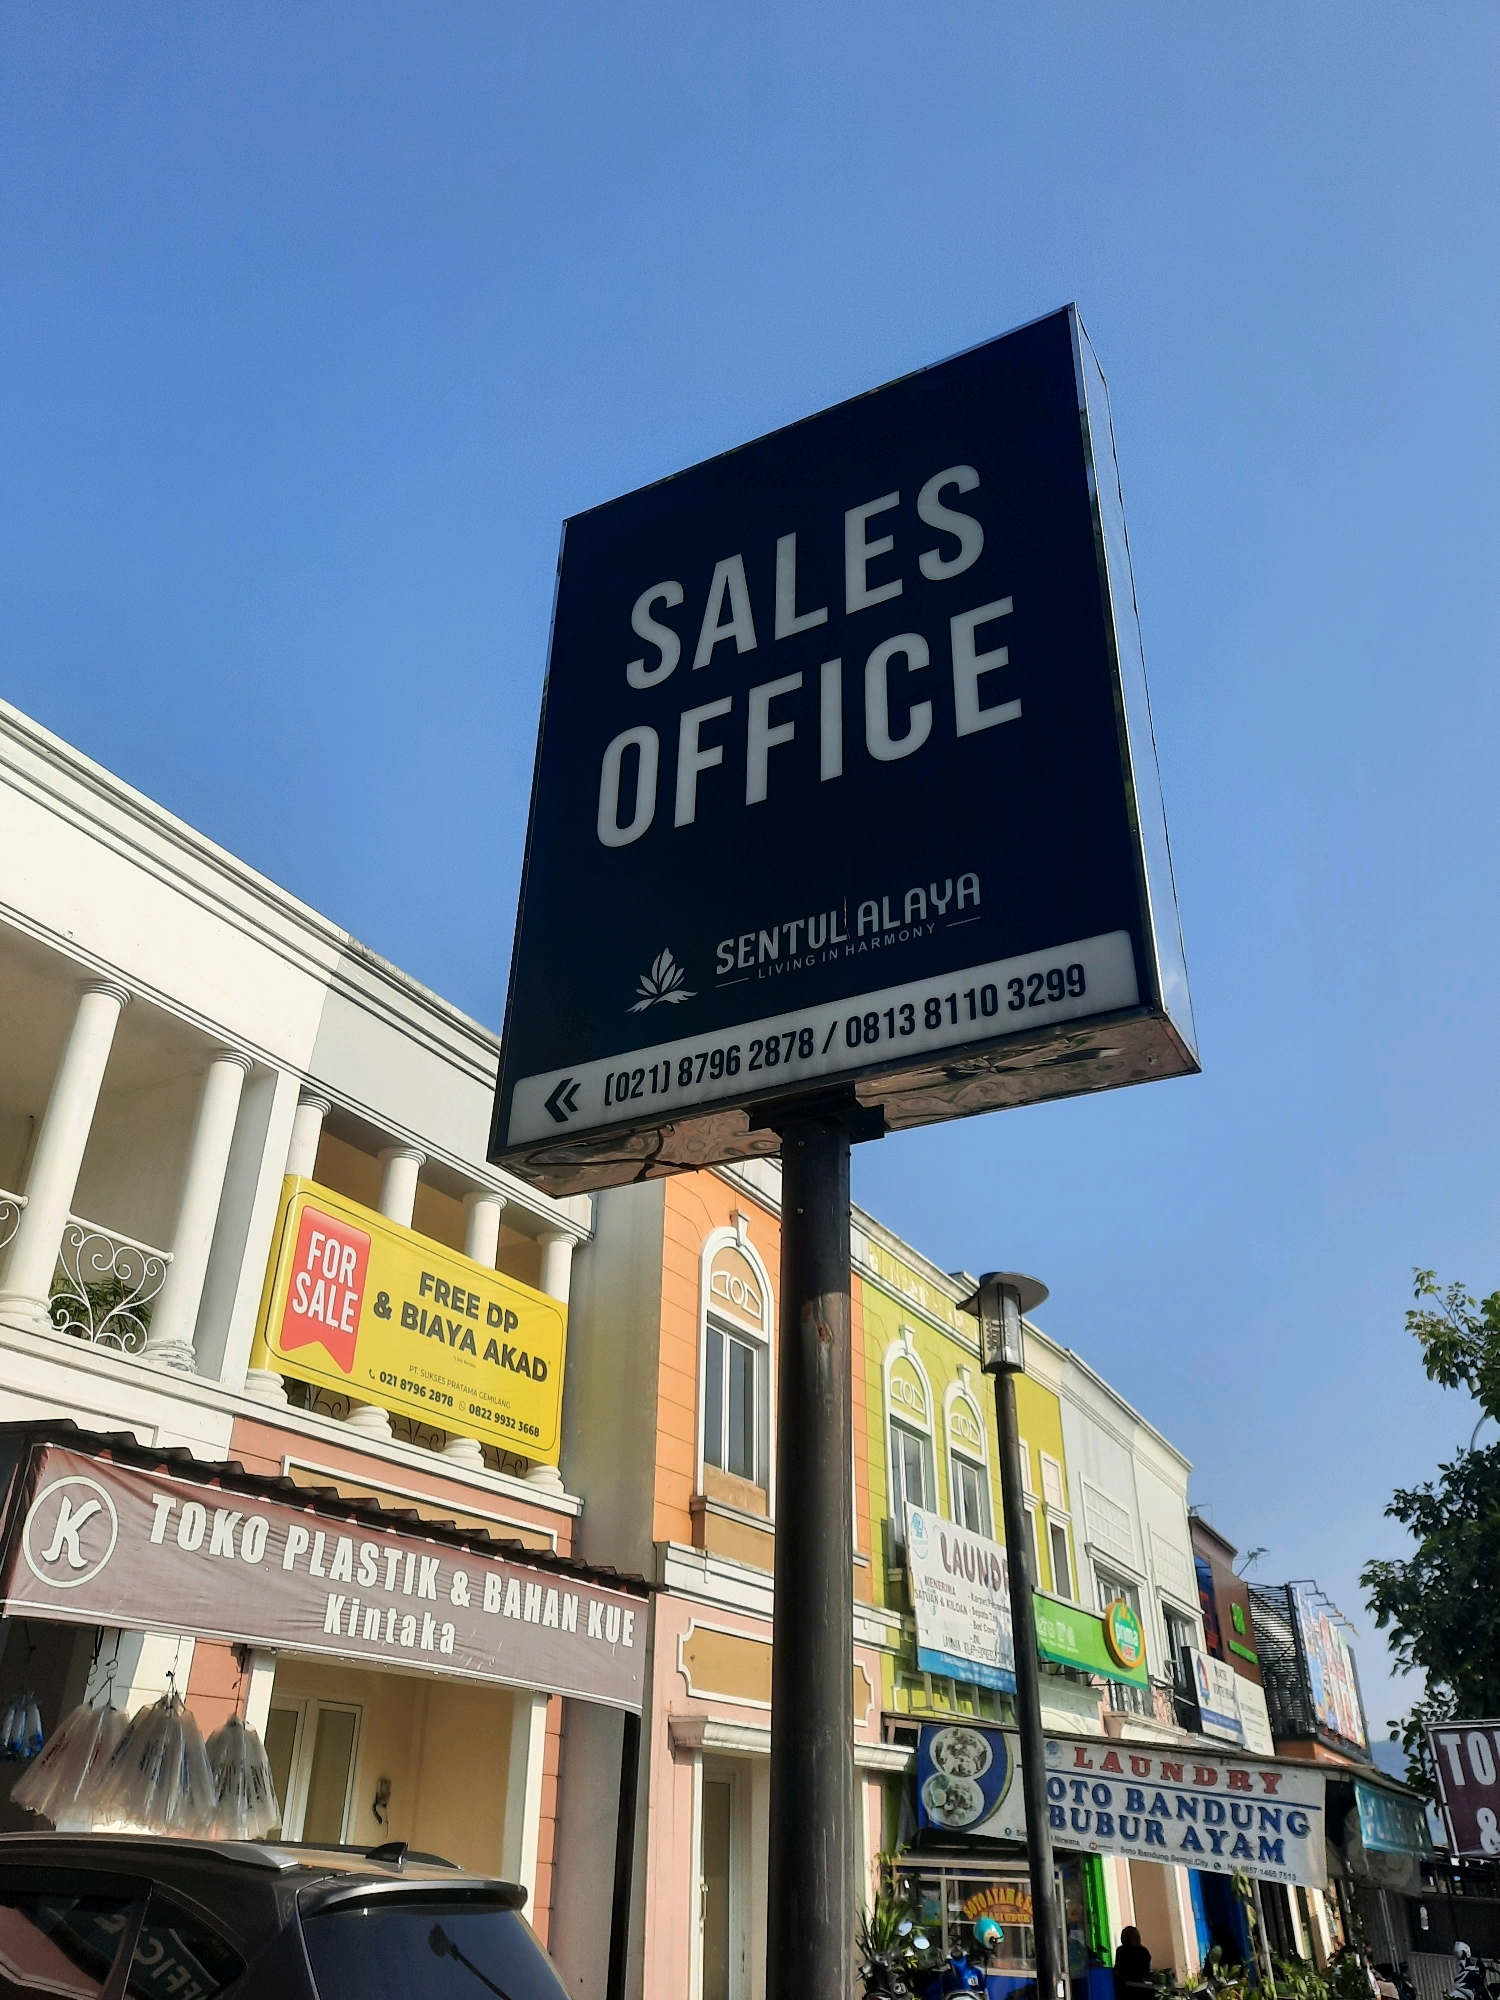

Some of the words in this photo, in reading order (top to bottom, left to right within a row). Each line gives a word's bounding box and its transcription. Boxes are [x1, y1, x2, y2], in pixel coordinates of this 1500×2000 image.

[626, 465, 985, 690] SALES
[597, 596, 1023, 848] OFFICE
[716, 910, 847, 975] SENTUL
[857, 872, 981, 937] ALAYA
[758, 955, 815, 979] LIVING
[822, 948, 838, 963] IN
[845, 922, 936, 956] HARMONY
[604, 1059, 671, 1107] (021)
[678, 1045, 741, 1087] 8796
[749, 1027, 814, 1071] 2878
[822, 1020, 838, 1054] /
[845, 1004, 916, 1048] 0813
[924, 984, 998, 1030] 8110
[1007, 963, 1086, 1011] 3299
[306, 1230, 357, 1287] FOR
[292, 1271, 359, 1334] SALE
[373, 1291, 392, 1320] &
[400, 1301, 477, 1356] BIAYA
[418, 1271, 481, 1321] FREE
[486, 1301, 519, 1334] DP
[379, 1371, 398, 1387] 021
[400, 1378, 426, 1397] 8796
[428, 1389, 454, 1407] 2878
[409, 1364, 419, 1375] PT.
[420, 1367, 446, 1385] SUKSES
[447, 1380, 478, 1397] PRATAMA
[479, 1391, 511, 1409] GEMILANG
[469, 1403, 491, 1420] 0822
[494, 1412, 516, 1429] 9932
[518, 1421, 540, 1438] 3668
[150, 1493, 270, 1564] TOKO
[282, 1524, 442, 1601] PLASTIK
[451, 1570, 472, 1608] &
[483, 1571, 580, 1633] BAHAN
[587, 1599, 635, 1648] KUE
[915, 1588, 939, 1605] SATUAN
[323, 1593, 457, 1655] Kintaka
[1074, 1746, 1282, 1795] LAUNDRY
[1439, 1731, 1500, 1786] TO
[1050, 1804, 1167, 1848] BUBUR
[1180, 1825, 1287, 1866] AYAM
[1125, 1787, 1311, 1839] BANDUNG
[1121, 1846, 1136, 1855] Soto
[1138, 1849, 1169, 1862] Bandung
